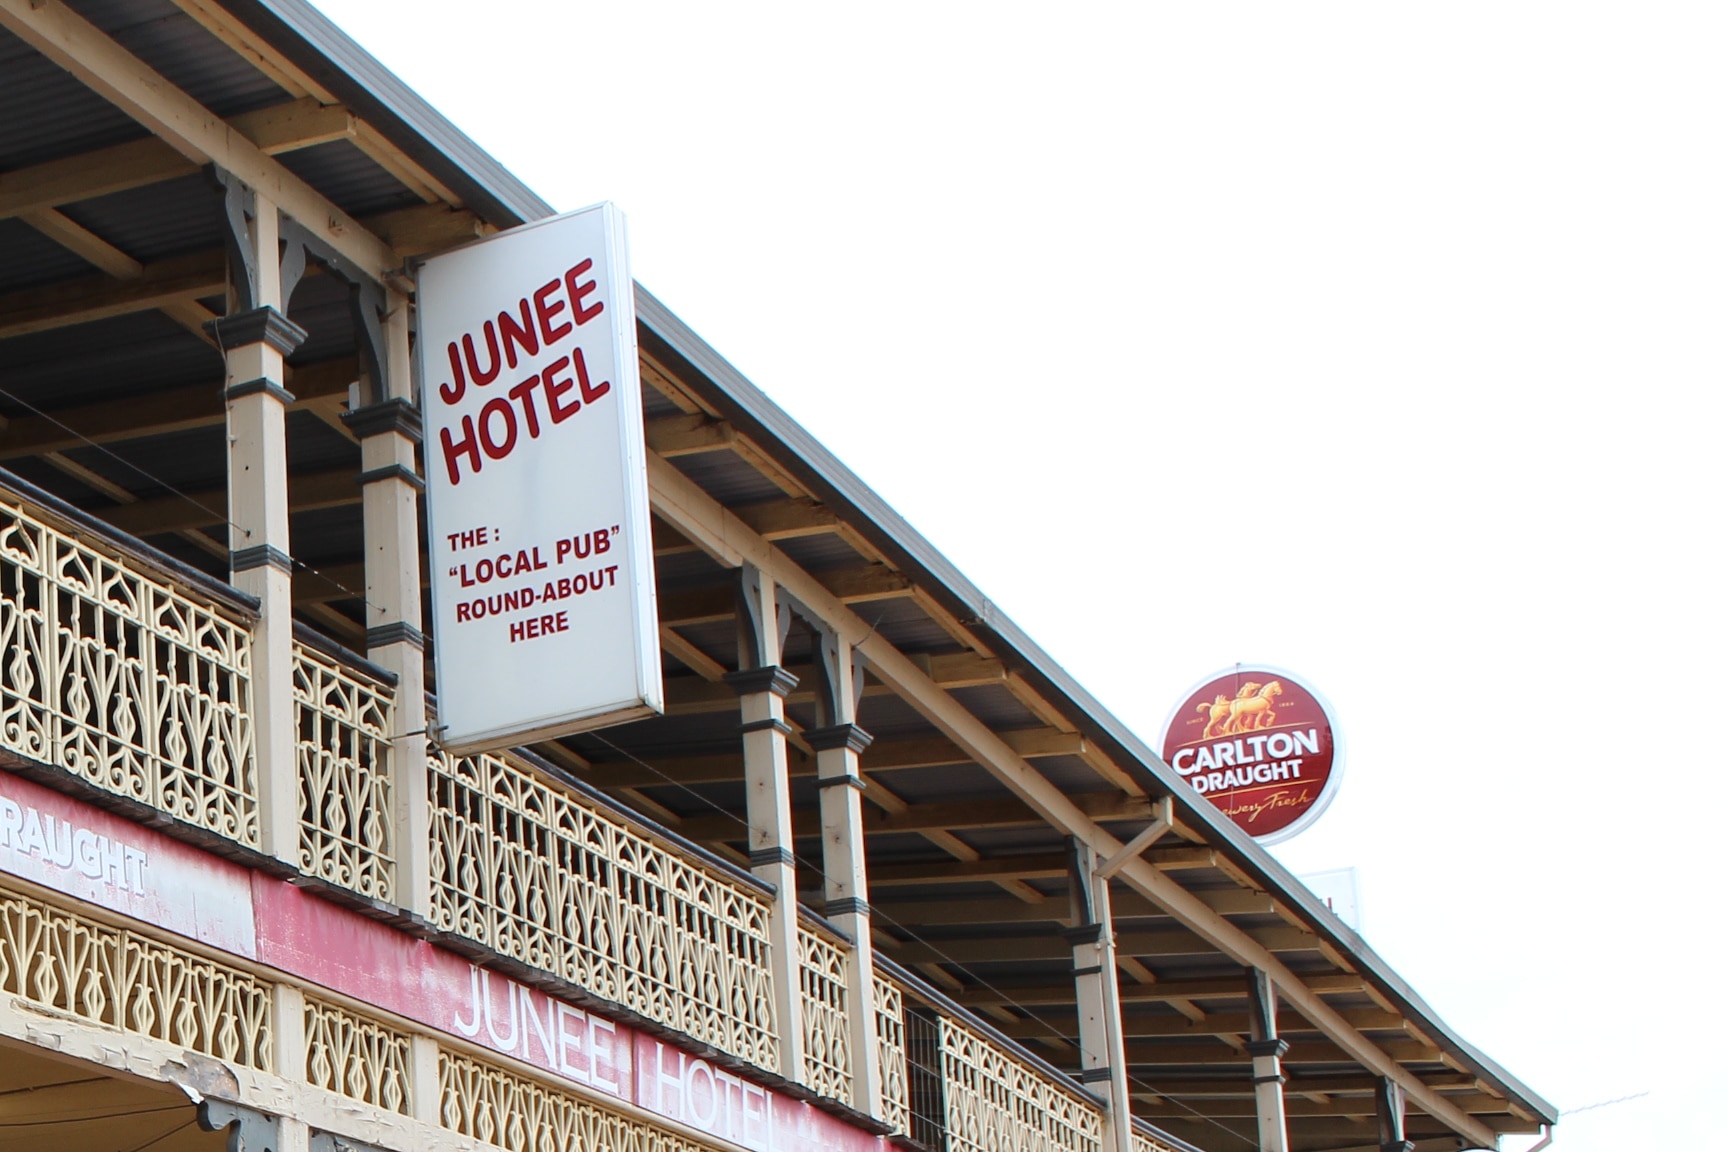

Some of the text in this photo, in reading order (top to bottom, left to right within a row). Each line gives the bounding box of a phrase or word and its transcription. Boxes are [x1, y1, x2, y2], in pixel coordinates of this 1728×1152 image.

[439, 257, 604, 405] JUNEE
[440, 347, 610, 486] HOTEL
[447, 526, 488, 551] THE
[456, 565, 618, 623] ROUND-ABOUT
[510, 610, 569, 643] HERE
[1171, 729, 1320, 776] CARLTON
[1191, 759, 1303, 794] DRAUGHT
[454, 964, 619, 1095] JUNEE
